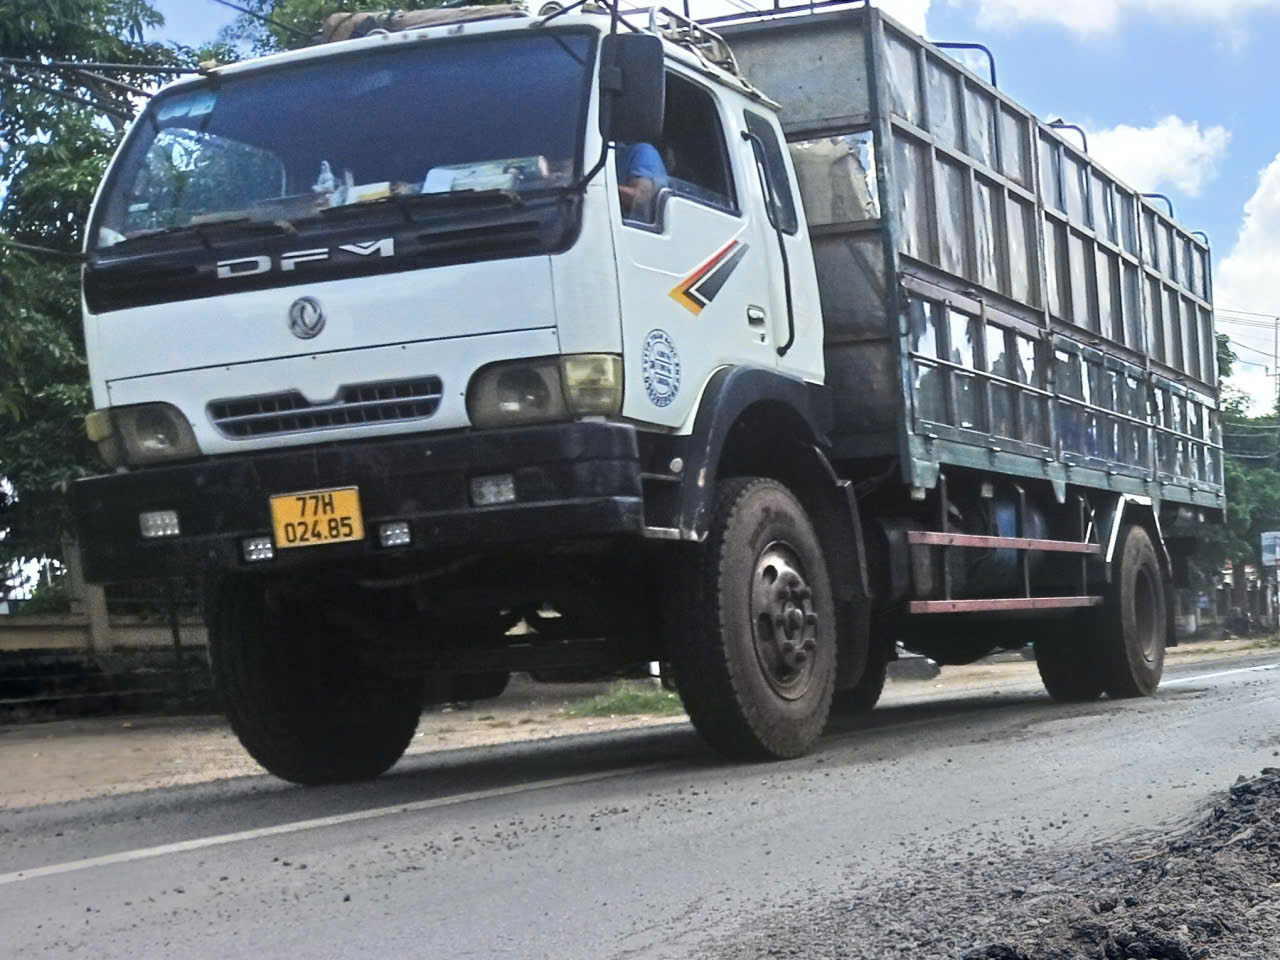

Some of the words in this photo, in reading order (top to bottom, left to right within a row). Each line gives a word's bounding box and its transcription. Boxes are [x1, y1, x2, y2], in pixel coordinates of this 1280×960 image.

[217, 238, 394, 278] DFM
[296, 494, 335, 517] 77H
[284, 516, 353, 543] 024.85
